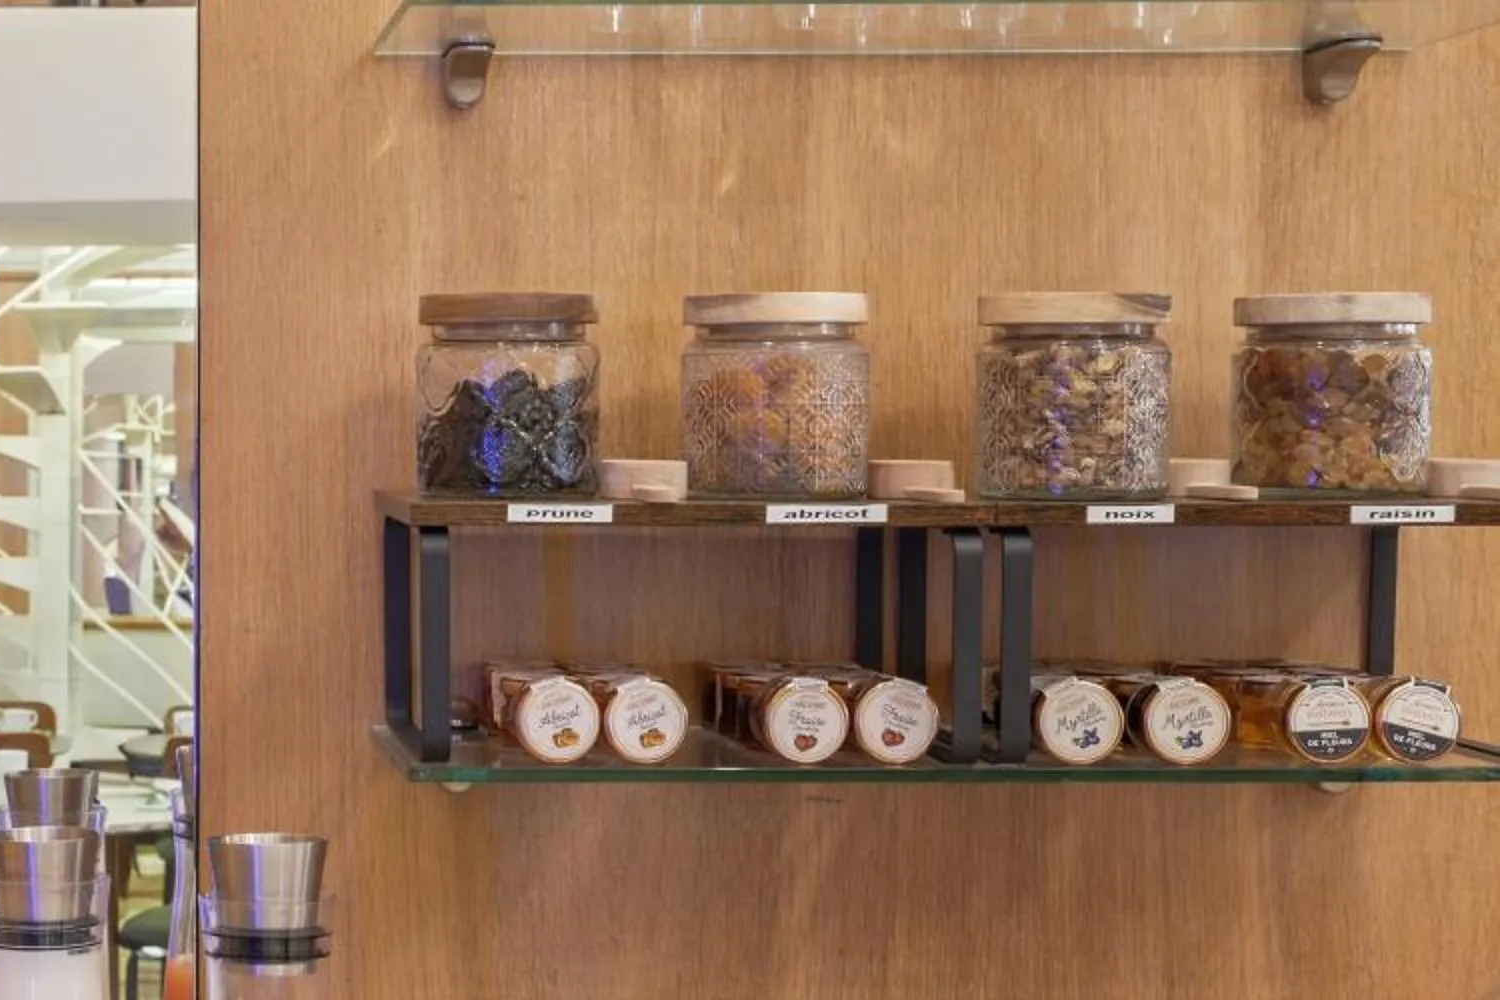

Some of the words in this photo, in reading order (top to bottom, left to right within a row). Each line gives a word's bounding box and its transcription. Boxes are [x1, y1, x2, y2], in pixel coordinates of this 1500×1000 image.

[526, 509, 594, 519] prune
[783, 508, 869, 519] abricot
[1104, 509, 1156, 519] noix
[1369, 509, 1436, 519] raisin
